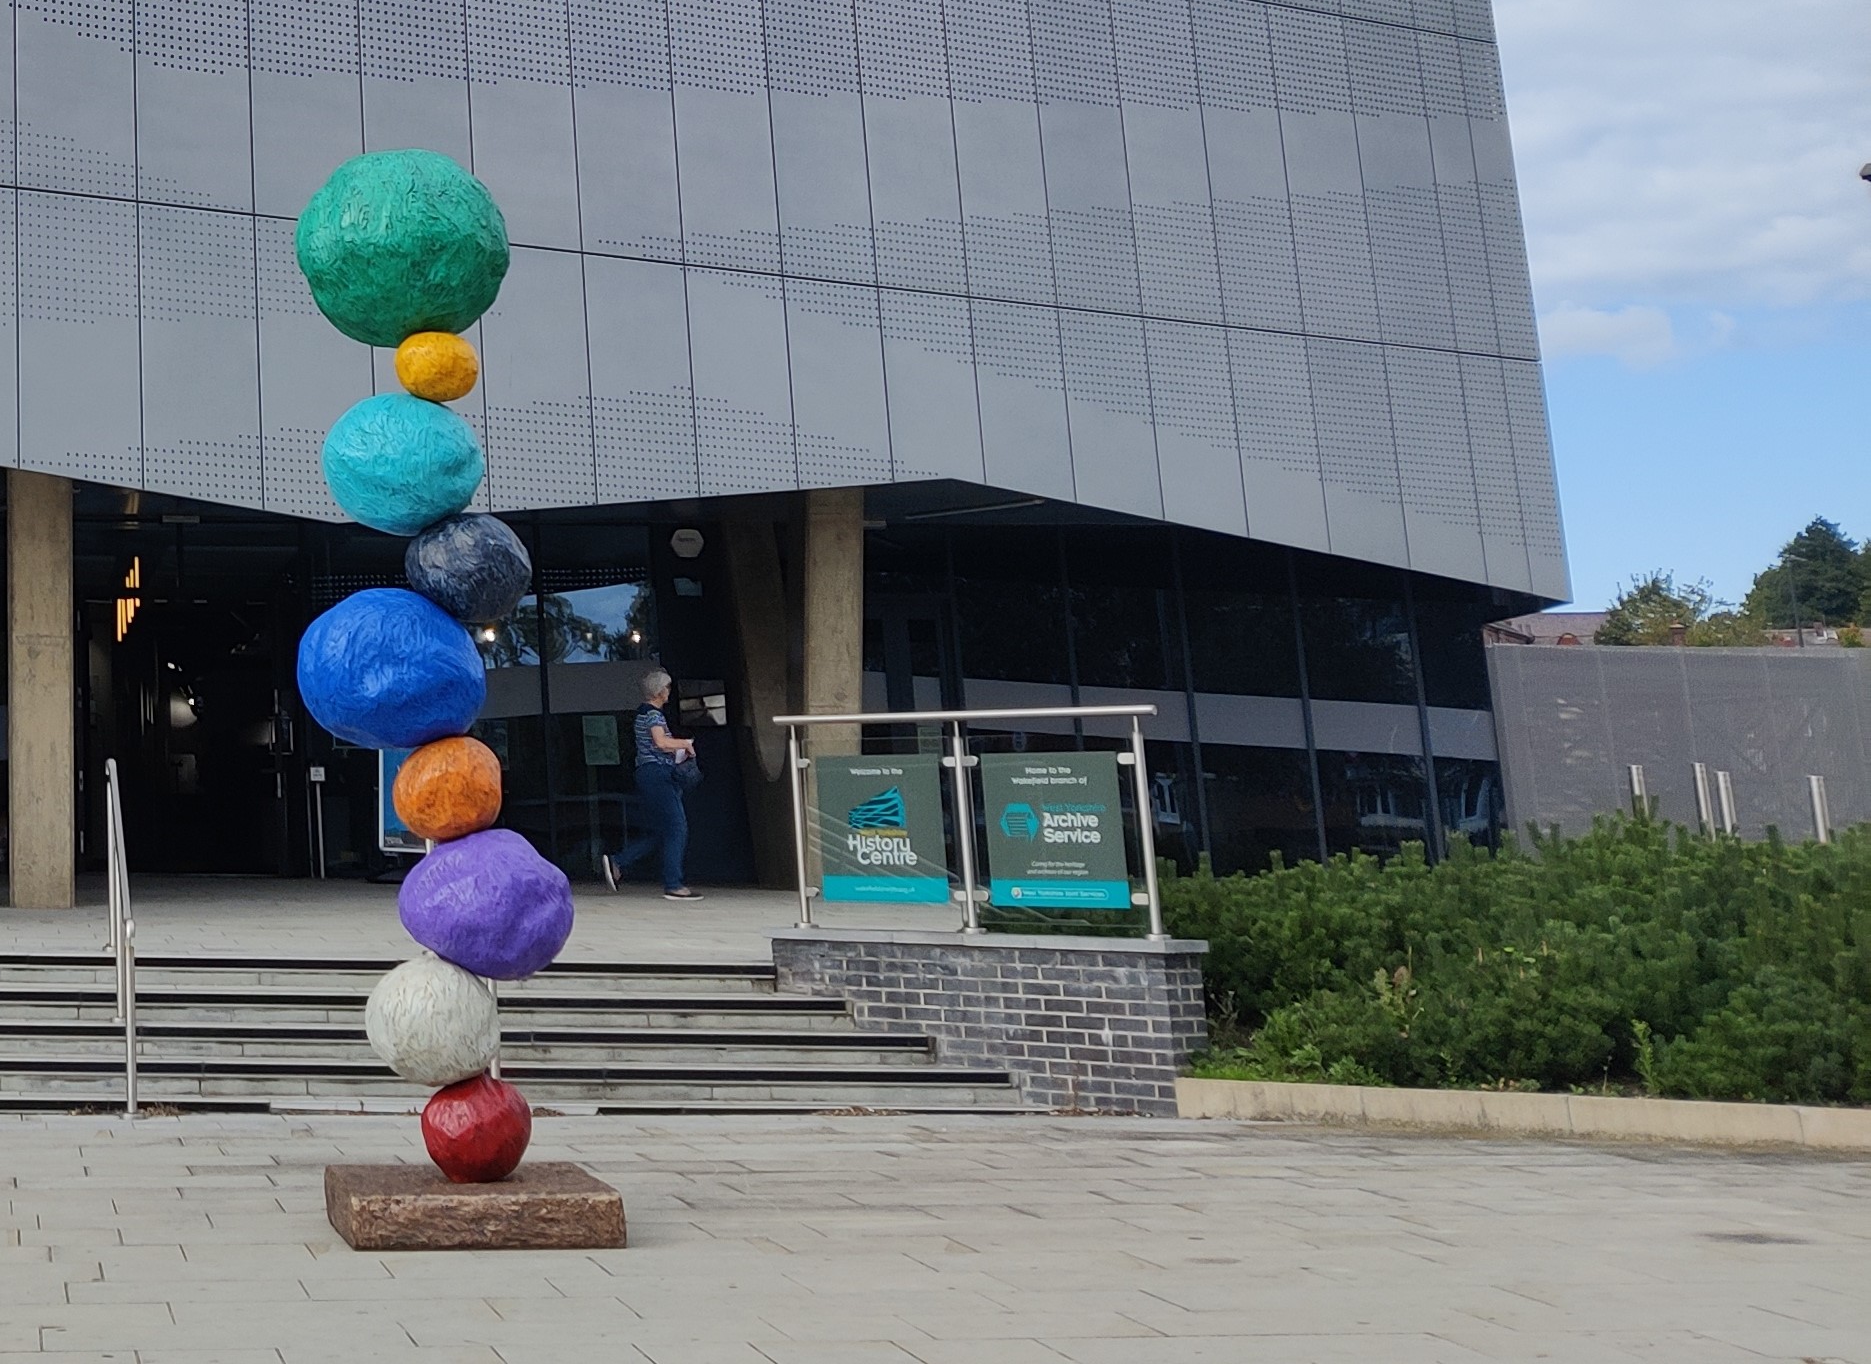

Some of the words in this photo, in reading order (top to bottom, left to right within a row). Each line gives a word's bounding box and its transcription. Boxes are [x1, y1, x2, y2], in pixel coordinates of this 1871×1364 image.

[1042, 812, 1099, 828] Archive
[848, 834, 911, 851] History
[1043, 828, 1102, 844] Service
[857, 849, 918, 865] Centre
